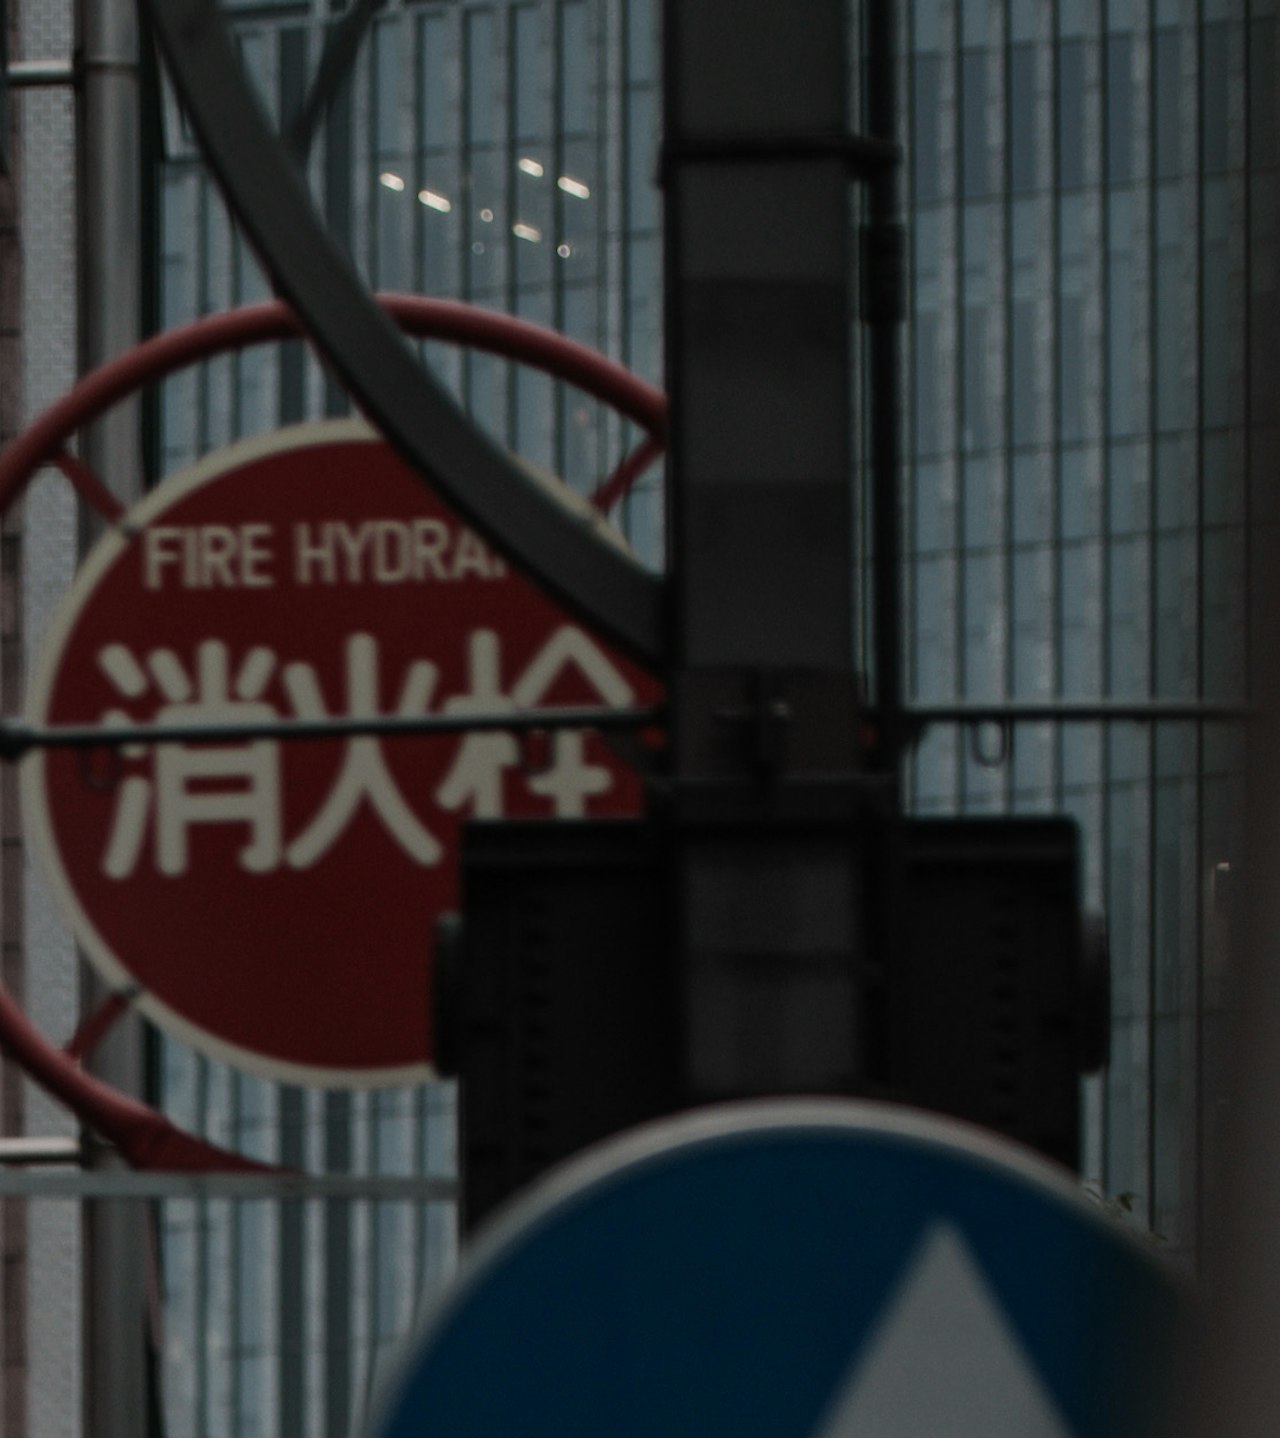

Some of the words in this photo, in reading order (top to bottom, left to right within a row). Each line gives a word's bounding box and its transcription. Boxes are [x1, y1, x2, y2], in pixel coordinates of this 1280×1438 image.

[143, 522, 275, 590] FIRE
[294, 518, 508, 588] HYDRA
[96, 622, 638, 880] 消火栓
